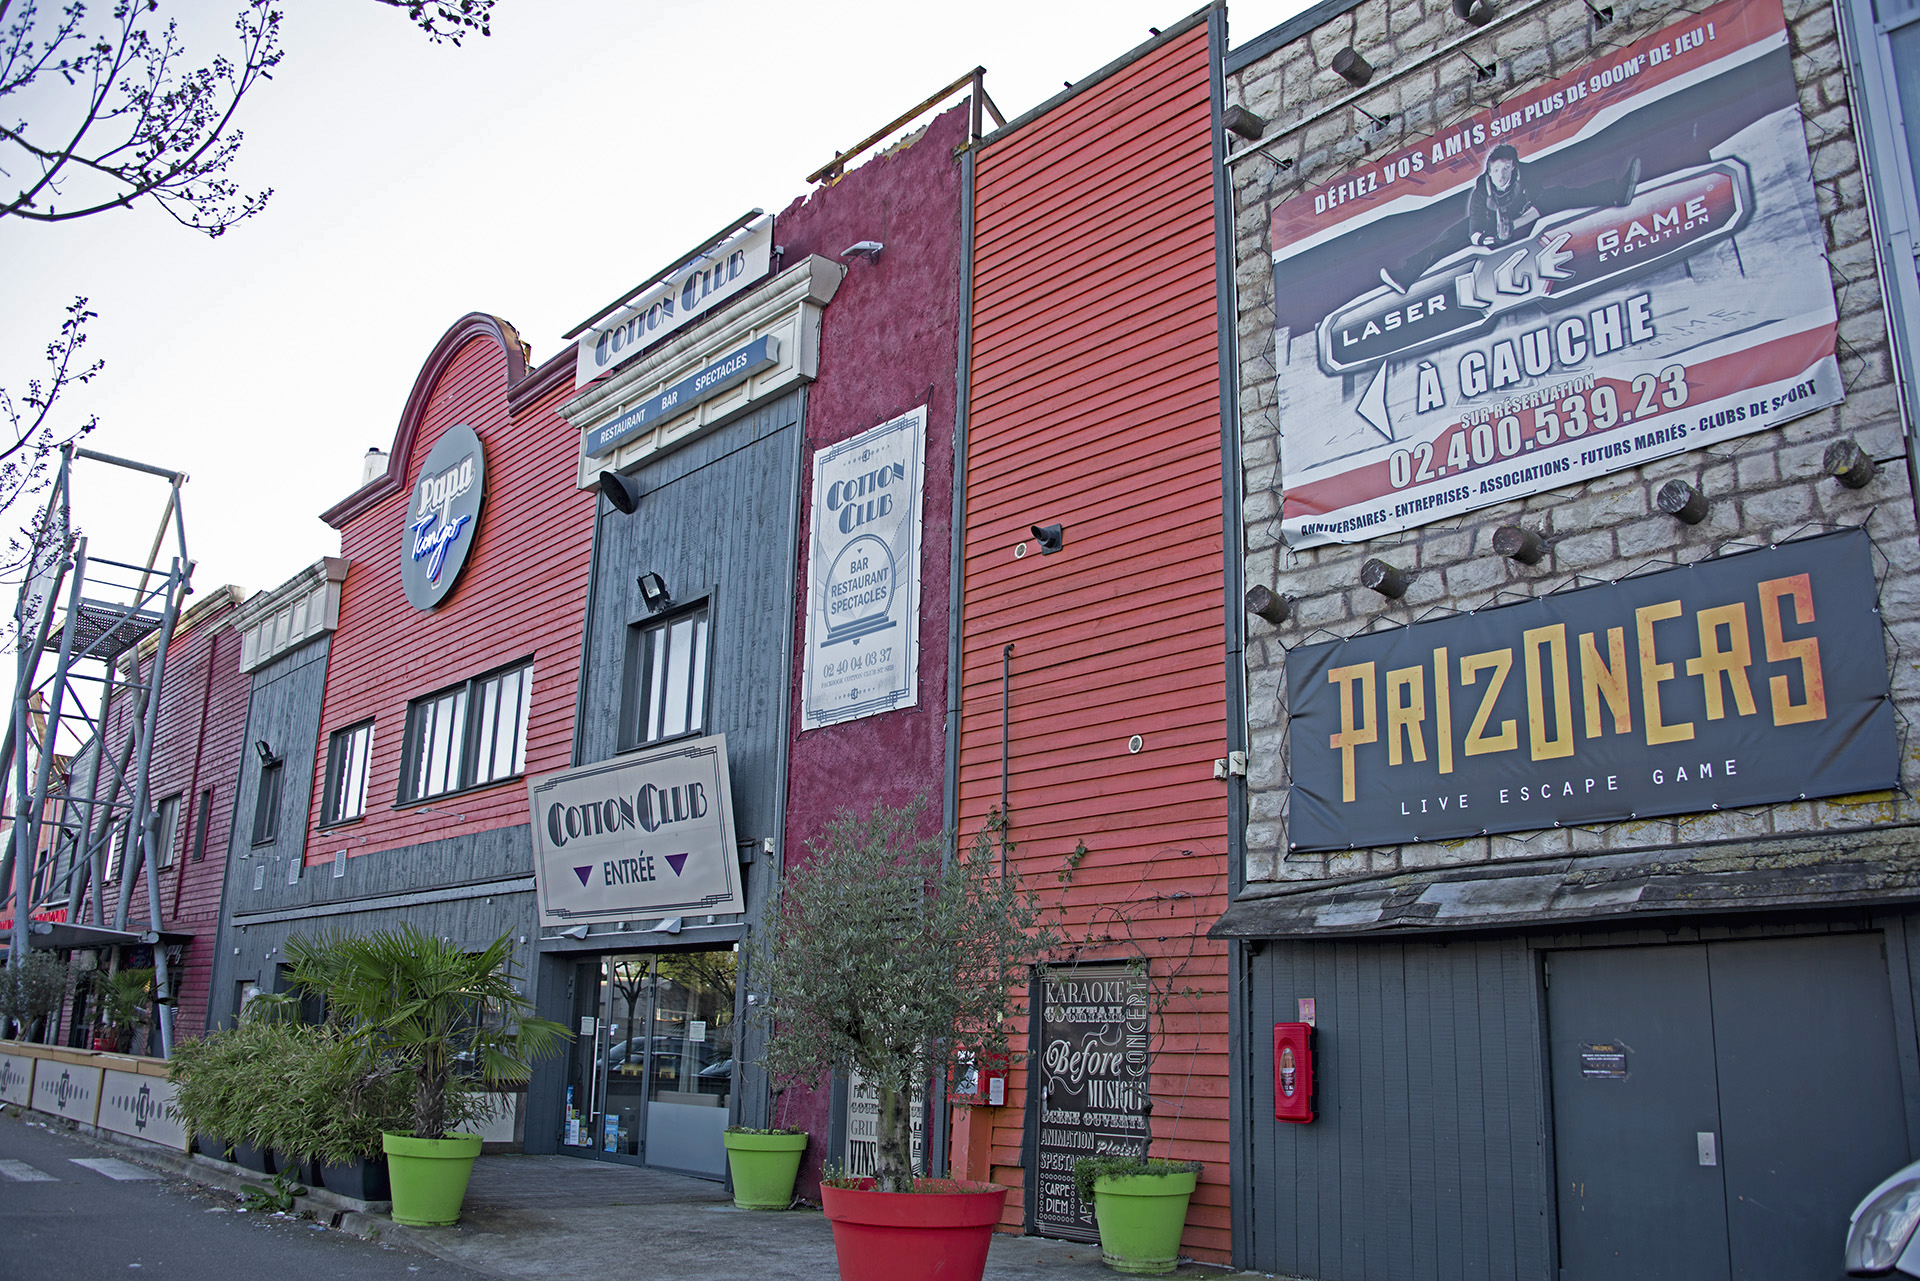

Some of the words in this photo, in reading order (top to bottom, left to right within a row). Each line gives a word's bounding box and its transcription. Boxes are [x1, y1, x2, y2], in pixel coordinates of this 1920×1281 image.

[1314, 171, 1377, 215] DÉFIEZ
[1383, 151, 1424, 185] VOS
[1431, 124, 1486, 165] AMIS
[1490, 111, 1523, 137] SUR
[1524, 92, 1564, 124] PLUS
[1566, 80, 1588, 104] DE
[1649, 42, 1672, 67] DE
[1674, 27, 1705, 56] JEU
[1599, 214, 1709, 262] EVOLUTION
[1342, 294, 1447, 347] LASER
[1597, 195, 1707, 252] GAME
[1416, 361, 1446, 414] À
[1459, 292, 1656, 399] GAUCHE
[600, 408, 646, 445] RESTAURANT
[661, 391, 678, 411] BAR
[694, 352, 748, 391] SPECTACLES
[1461, 408, 1490, 431] SUR
[1494, 373, 1596, 418] RÉSERVATION
[1388, 363, 1689, 490] 02.400.539.23
[827, 458, 905, 511] COTTON
[1301, 509, 1387, 536] ANNIVERSAIRES
[1395, 486, 1470, 517] ENTREPRISES
[1479, 457, 1570, 494] ASSOCIATIONS
[1581, 440, 1631, 466] FUTURS
[1634, 424, 1687, 450] MARIÉS
[1699, 406, 1746, 431] CLUBS
[1750, 401, 1768, 417] DE
[839, 493, 893, 535] CLUB
[831, 567, 889, 598] RESTAURANT
[850, 557, 869, 575] BAR
[831, 586, 887, 615] SPECTACLES
[823, 663, 835, 679] 02
[837, 660, 849, 675] 40
[850, 656, 862, 671] 04
[865, 652, 877, 667] 03
[880, 647, 893, 662] 37
[1328, 573, 1827, 802] PRIZONERS
[1401, 794, 1468, 815] LIVE
[1499, 775, 1618, 804] ESCAPE
[1652, 759, 1736, 785] GAME
[547, 795, 636, 847] COTTON
[636, 782, 708, 833] CLUB
[603, 850, 656, 886] ENTRÉE
[1044, 978, 1125, 1003] KARAOKÉ
[1044, 1006, 1126, 1023] COCKTAIL
[1126, 979, 1147, 1077] CONCERT
[1046, 1039, 1123, 1084] Before
[1040, 1128, 1095, 1149] ANIMATION
[1045, 1182, 1070, 1197] CARPE
[1045, 1198, 1069, 1215] DIEM
